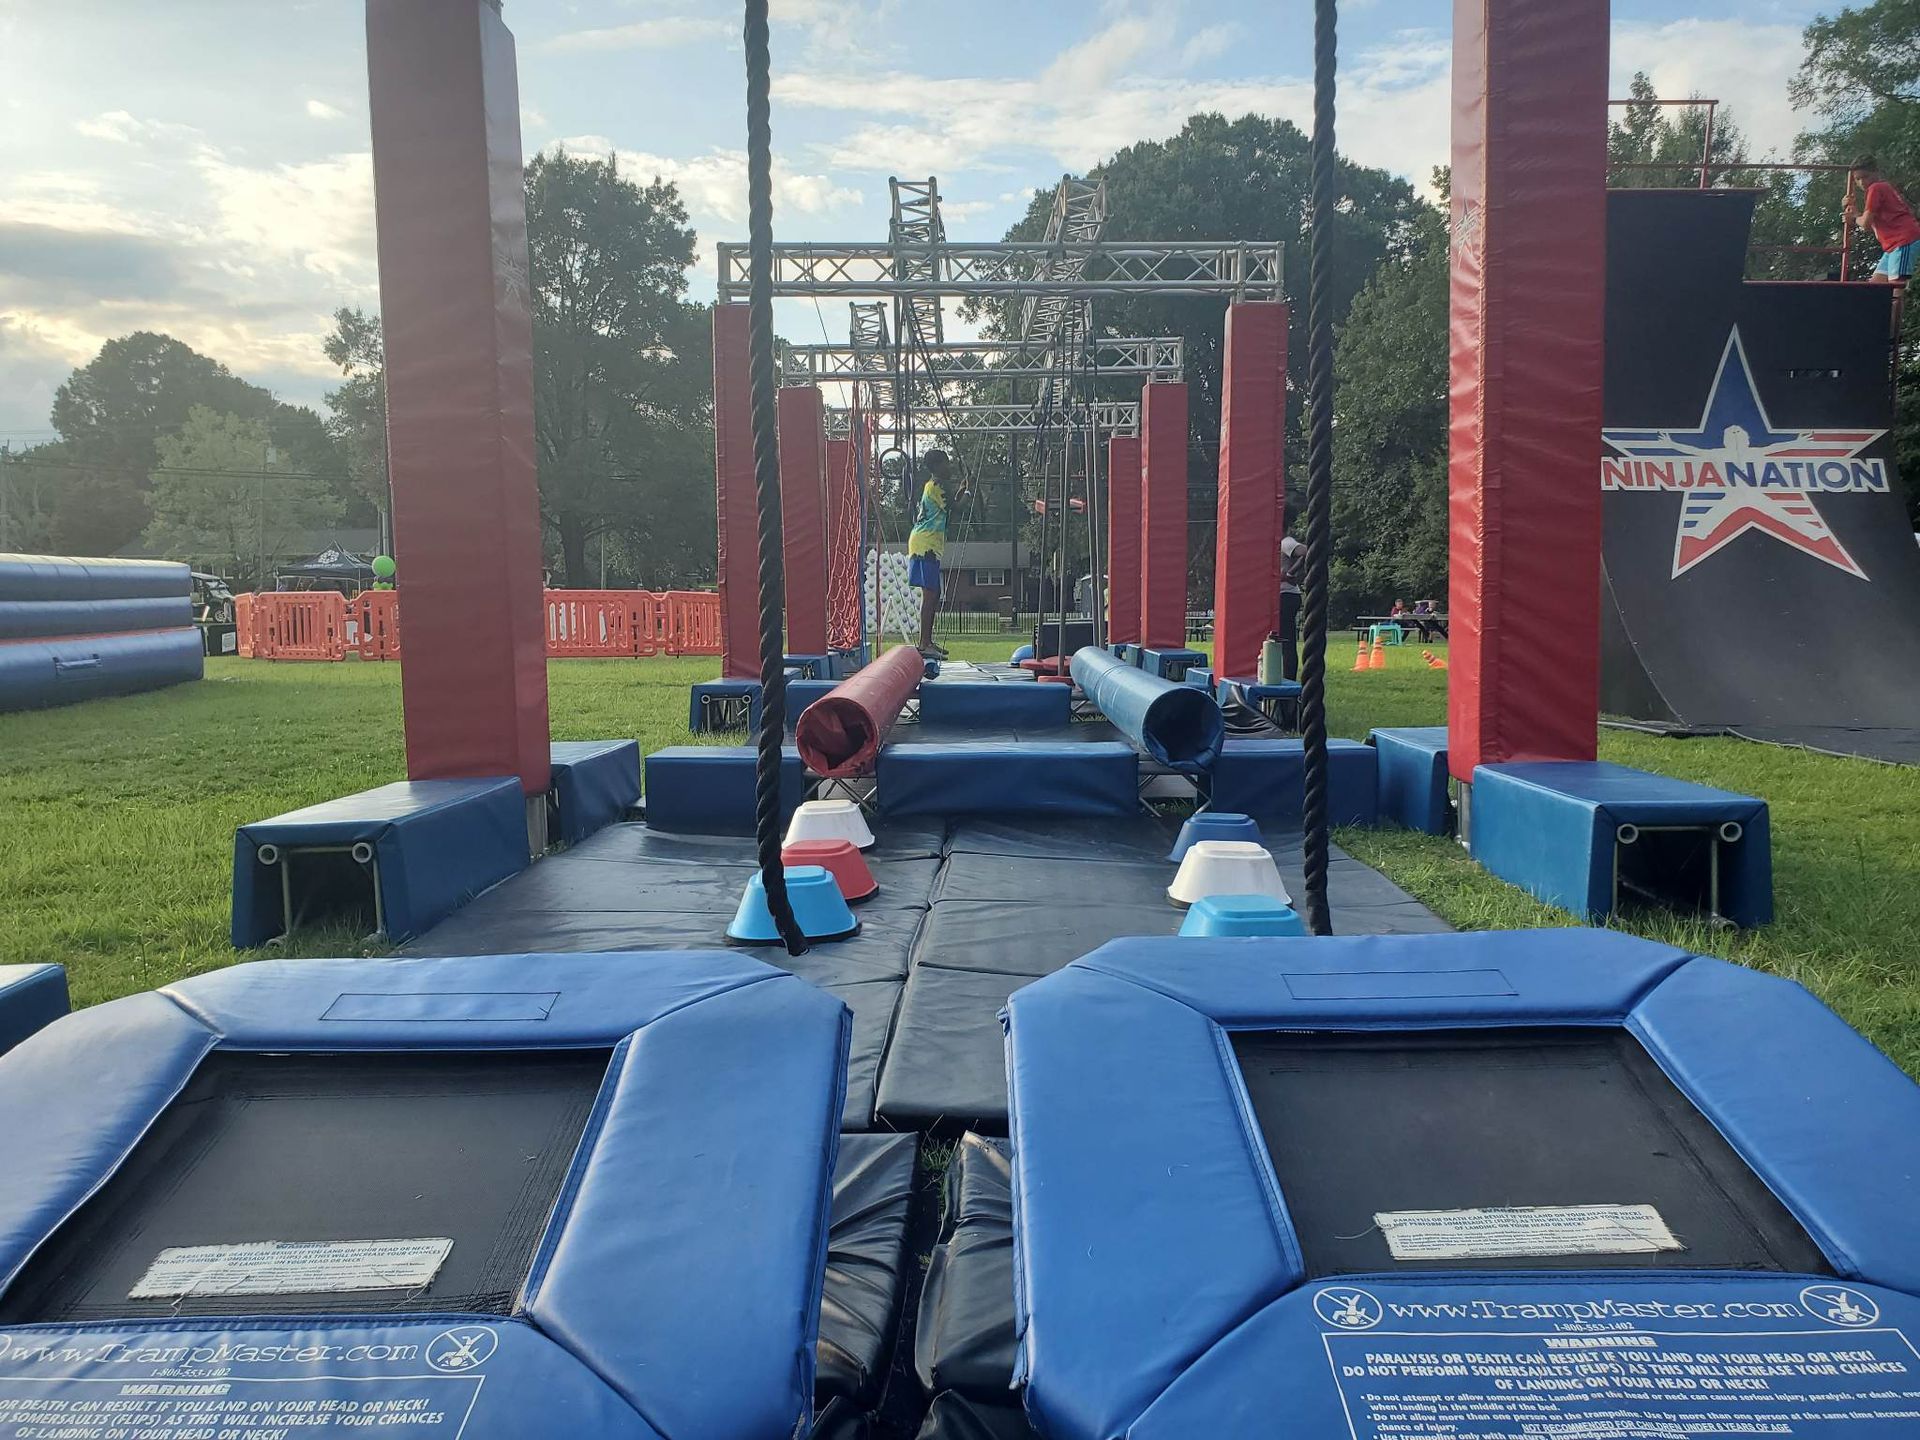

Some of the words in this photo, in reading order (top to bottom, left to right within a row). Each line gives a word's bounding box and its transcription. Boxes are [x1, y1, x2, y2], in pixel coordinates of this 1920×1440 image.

[1387, 1299, 1803, 1324] www.TrampMaster.com
[1554, 1322, 1635, 1332] 1-800-553-1402
[1543, 1336, 1658, 1349] WARNING
[11, 1343, 419, 1368] www.TrampMaster.com
[1365, 1353, 1440, 1364] PARALYSIS
[1442, 1353, 1463, 1364] OR
[1465, 1353, 1514, 1364] DEATH
[1516, 1353, 1547, 1364] CAN
[1549, 1351, 1600, 1364] RESULT
[1602, 1351, 1616, 1362] IF
[1618, 1351, 1651, 1362] YOU
[1652, 1352, 1693, 1363] LAND
[1696, 1353, 1720, 1364] ON
[1720, 1353, 1764, 1364] YOUR
[1763, 1353, 1805, 1363] HEAD
[1807, 1352, 1832, 1363] OR
[1830, 1350, 1876, 1362] NECK!
[150, 1367, 232, 1377] 1-800-553-1402
[1342, 1366, 1365, 1377] DO
[1368, 1365, 1398, 1376] NOT
[1401, 1365, 1469, 1376] PERFORM
[1470, 1365, 1573, 1377] SOMERSAULTS
[1575, 1363, 1625, 1377] (FLIPS)
[1629, 1364, 1648, 1375] AS
[1648, 1364, 1684, 1375] THIS
[1684, 1365, 1724, 1376] WILL
[1724, 1365, 1796, 1376] INCREASE
[1796, 1364, 1840, 1376] YOUR
[1840, 1362, 1907, 1374] CHANCES
[117, 1383, 232, 1396] WARNING
[1494, 1379, 1514, 1390] OF
[1516, 1379, 1584, 1390] LANDING
[1585, 1376, 1610, 1388] ON
[1610, 1376, 1654, 1388] YOUR
[1654, 1378, 1697, 1389] HEAD
[1700, 1378, 1724, 1389] OR
[1723, 1378, 1770, 1390] NECK!
[1402, 1393, 1442, 1403] attempt
[1457, 1393, 1483, 1401] allow
[1486, 1393, 1547, 1402] somersaults.
[1548, 1392, 1590, 1401] Landing
[1605, 1390, 1623, 1398] the
[1624, 1391, 1650, 1400] head
[1664, 1392, 1689, 1400] neck
[1739, 1393, 1774, 1401] serious
[1869, 1390, 1902, 1399] death,
[0, 1400, 19, 1410] OR
[18, 1400, 67, 1412] DEATH
[70, 1400, 103, 1412] CAN
[102, 1400, 157, 1412] RESULT
[156, 1400, 174, 1412] IF
[174, 1400, 206, 1412] YOU
[206, 1400, 247, 1412] LAND
[249, 1400, 273, 1412] ON
[276, 1400, 316, 1412] YOUR
[317, 1399, 360, 1412] HEAD
[362, 1400, 382, 1413] OR
[385, 1398, 430, 1411] NECK!
[1370, 1403, 1398, 1411] when
[1399, 1403, 1437, 1413] landing
[1438, 1403, 1449, 1411] in
[1450, 1403, 1468, 1411] the
[1469, 1403, 1504, 1411] middle
[1506, 1403, 1517, 1411] of
[1519, 1403, 1536, 1411] the
[1537, 1403, 1561, 1411] bed.
[8, 1412, 111, 1425] SOMERSAULTS
[111, 1413, 162, 1427] (FLIPS)
[163, 1413, 185, 1425] AS
[188, 1413, 222, 1425] THIS
[222, 1413, 257, 1426] WILL
[260, 1413, 330, 1426] INCREASE
[335, 1413, 374, 1426] YOUR
[377, 1412, 445, 1425] CHANCES
[1373, 1413, 1388, 1421] Do
[1390, 1413, 1407, 1421] not
[1409, 1413, 1436, 1421] allow
[1513, 1413, 1547, 1422] person
[1564, 1412, 1582, 1420] the
[1583, 1410, 1643, 1419] trampoline.
[1643, 1411, 1662, 1420] Use
[1663, 1412, 1677, 1421] by
[1707, 1412, 1732, 1420] than
[1754, 1413, 1789, 1421] person
[1803, 1412, 1821, 1420] the
[1849, 1411, 1874, 1419] time
[15, 1426, 38, 1438] OF
[36, 1427, 103, 1439] LANDING
[106, 1426, 130, 1439] ON
[132, 1427, 172, 1440] YOUR
[173, 1427, 217, 1440] HEAD
[219, 1428, 240, 1440] OR
[240, 1428, 288, 1440] NECK!
[1377, 1423, 1412, 1431] chance
[1414, 1423, 1424, 1431] of
[1521, 1423, 1540, 1433] NOT
[1542, 1421, 1614, 1433] RECOMMENDED
[1615, 1420, 1638, 1430] FOR
[1636, 1420, 1682, 1432] CHILDREN
[1683, 1422, 1716, 1432] UNDER
[1722, 1423, 1755, 1432] YEARS
[1756, 1423, 1770, 1432] OF
[1770, 1423, 1791, 1432] AGE
